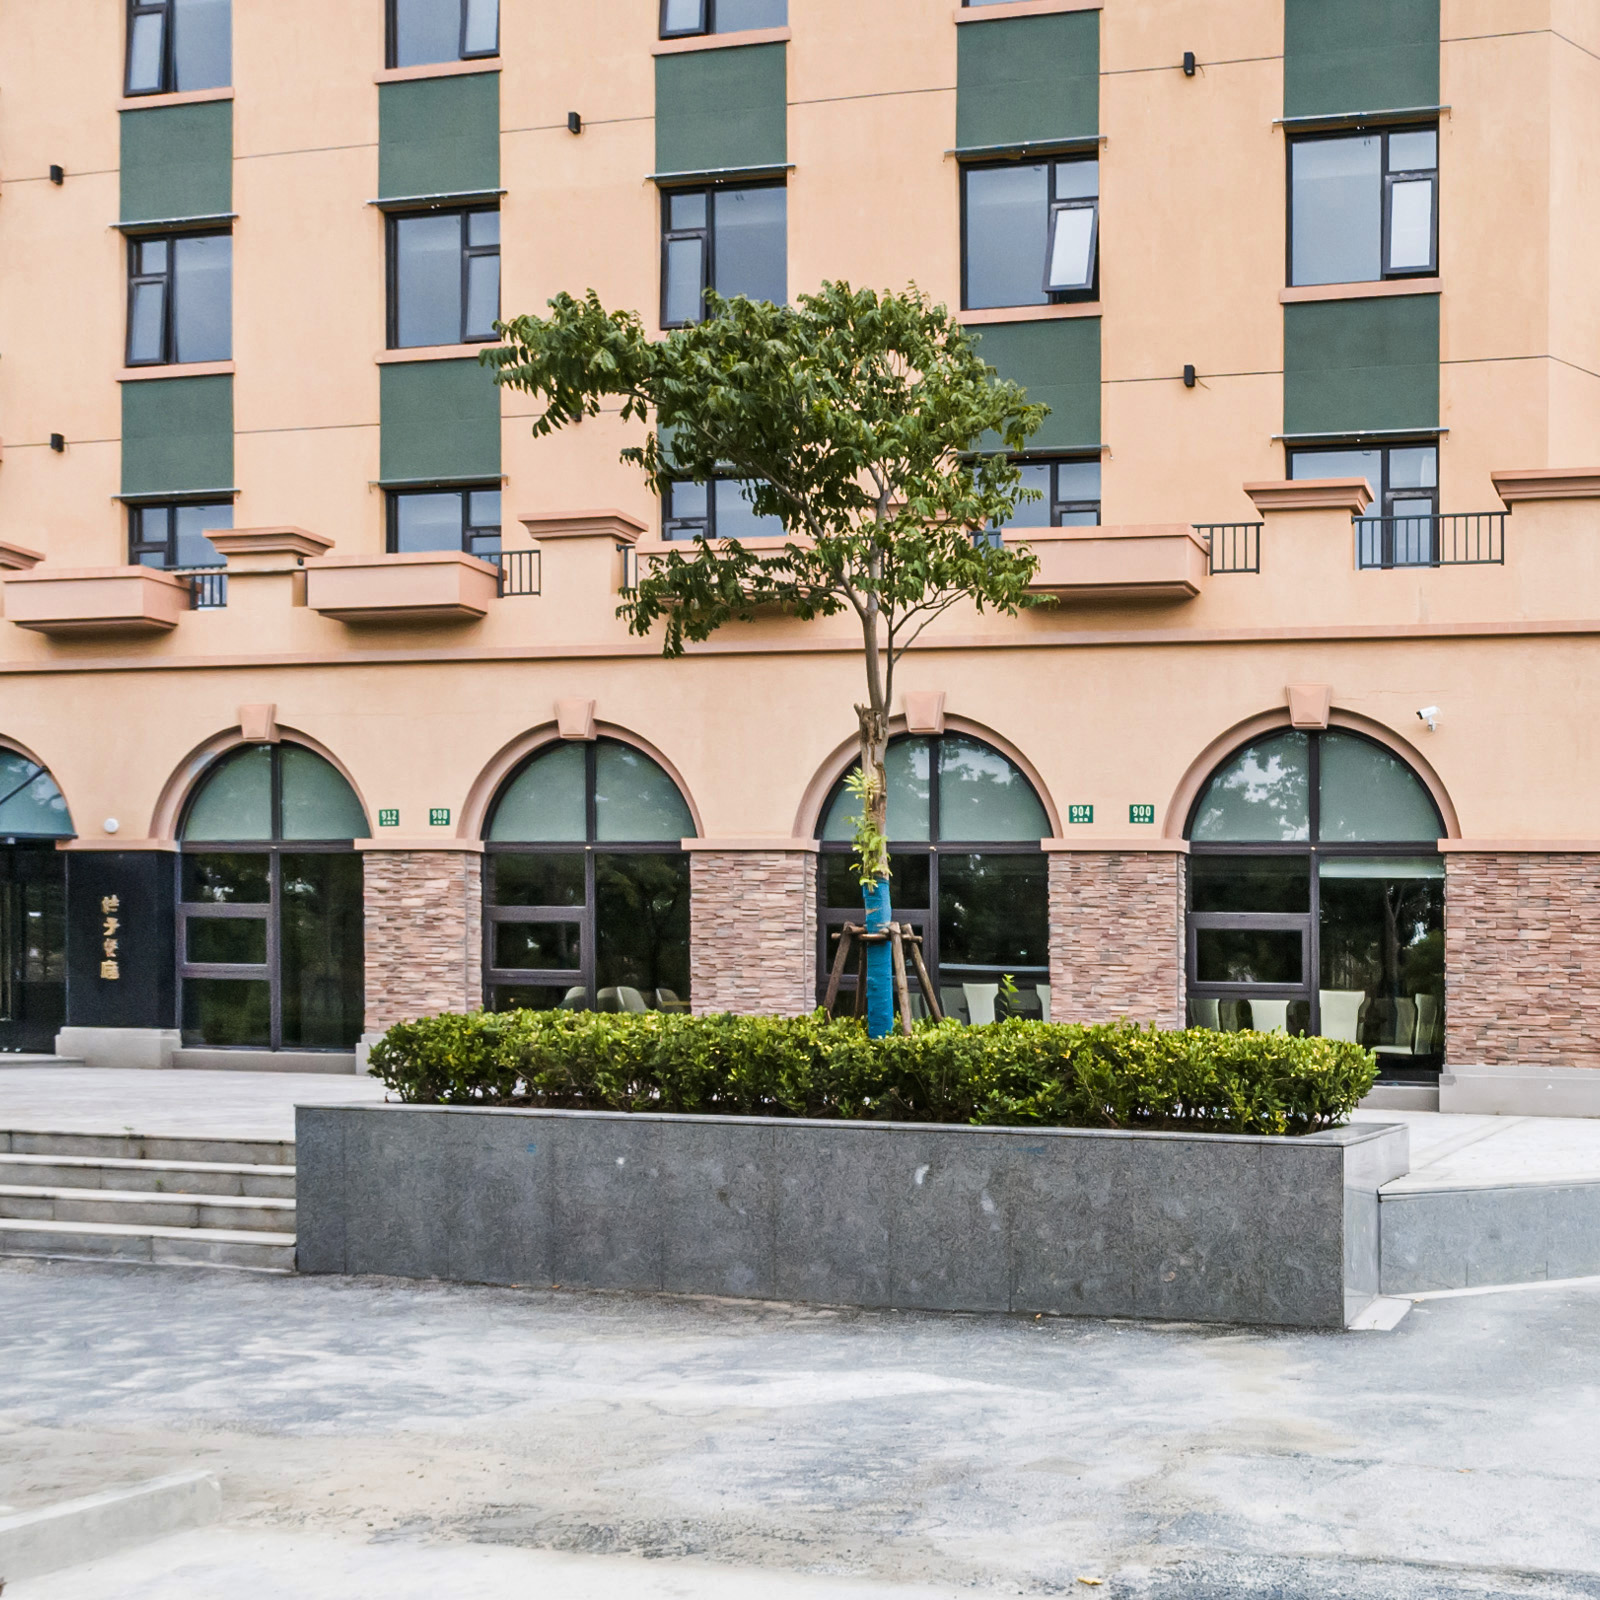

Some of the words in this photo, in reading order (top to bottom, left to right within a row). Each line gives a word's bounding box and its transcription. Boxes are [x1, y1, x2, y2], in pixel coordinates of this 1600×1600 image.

[381, 810, 397, 820] 912
[432, 810, 448, 819] 908
[1072, 806, 1090, 817] 904
[1132, 806, 1151, 817] 900
